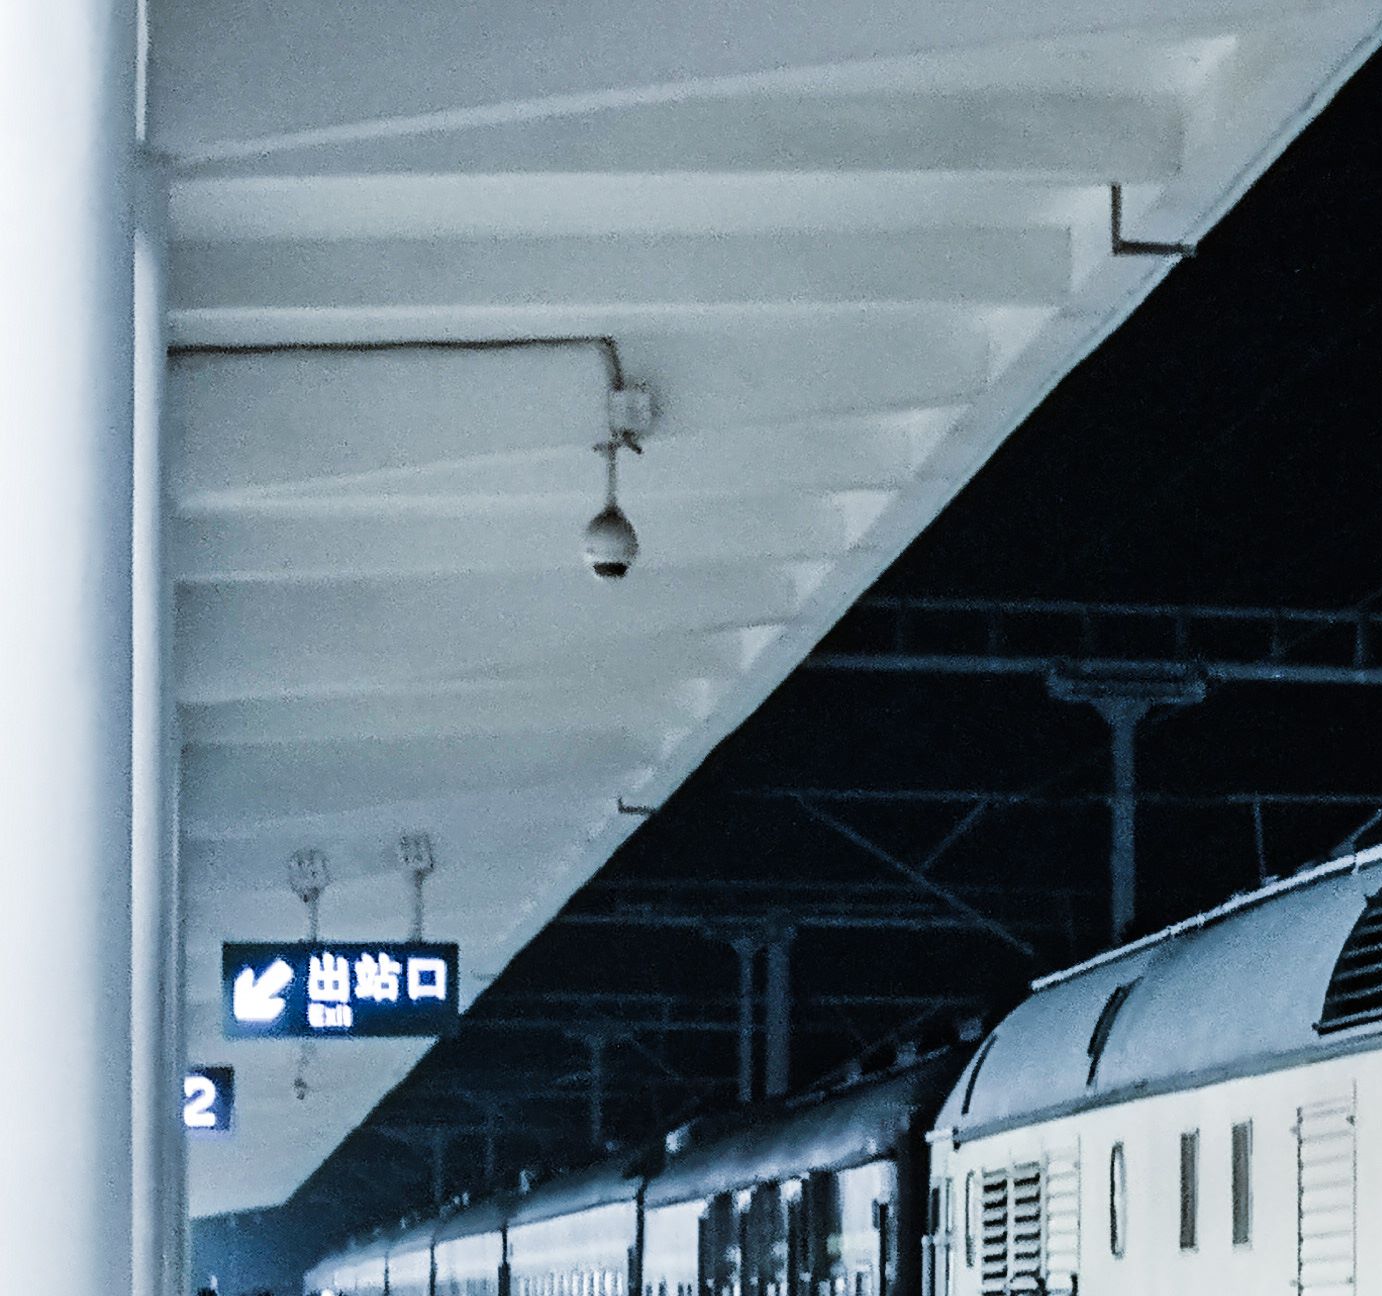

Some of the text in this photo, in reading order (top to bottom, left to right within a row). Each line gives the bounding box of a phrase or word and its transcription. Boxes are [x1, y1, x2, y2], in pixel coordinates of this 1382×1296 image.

[308, 951, 448, 1002] 出站口
[183, 1075, 217, 1128] 2
